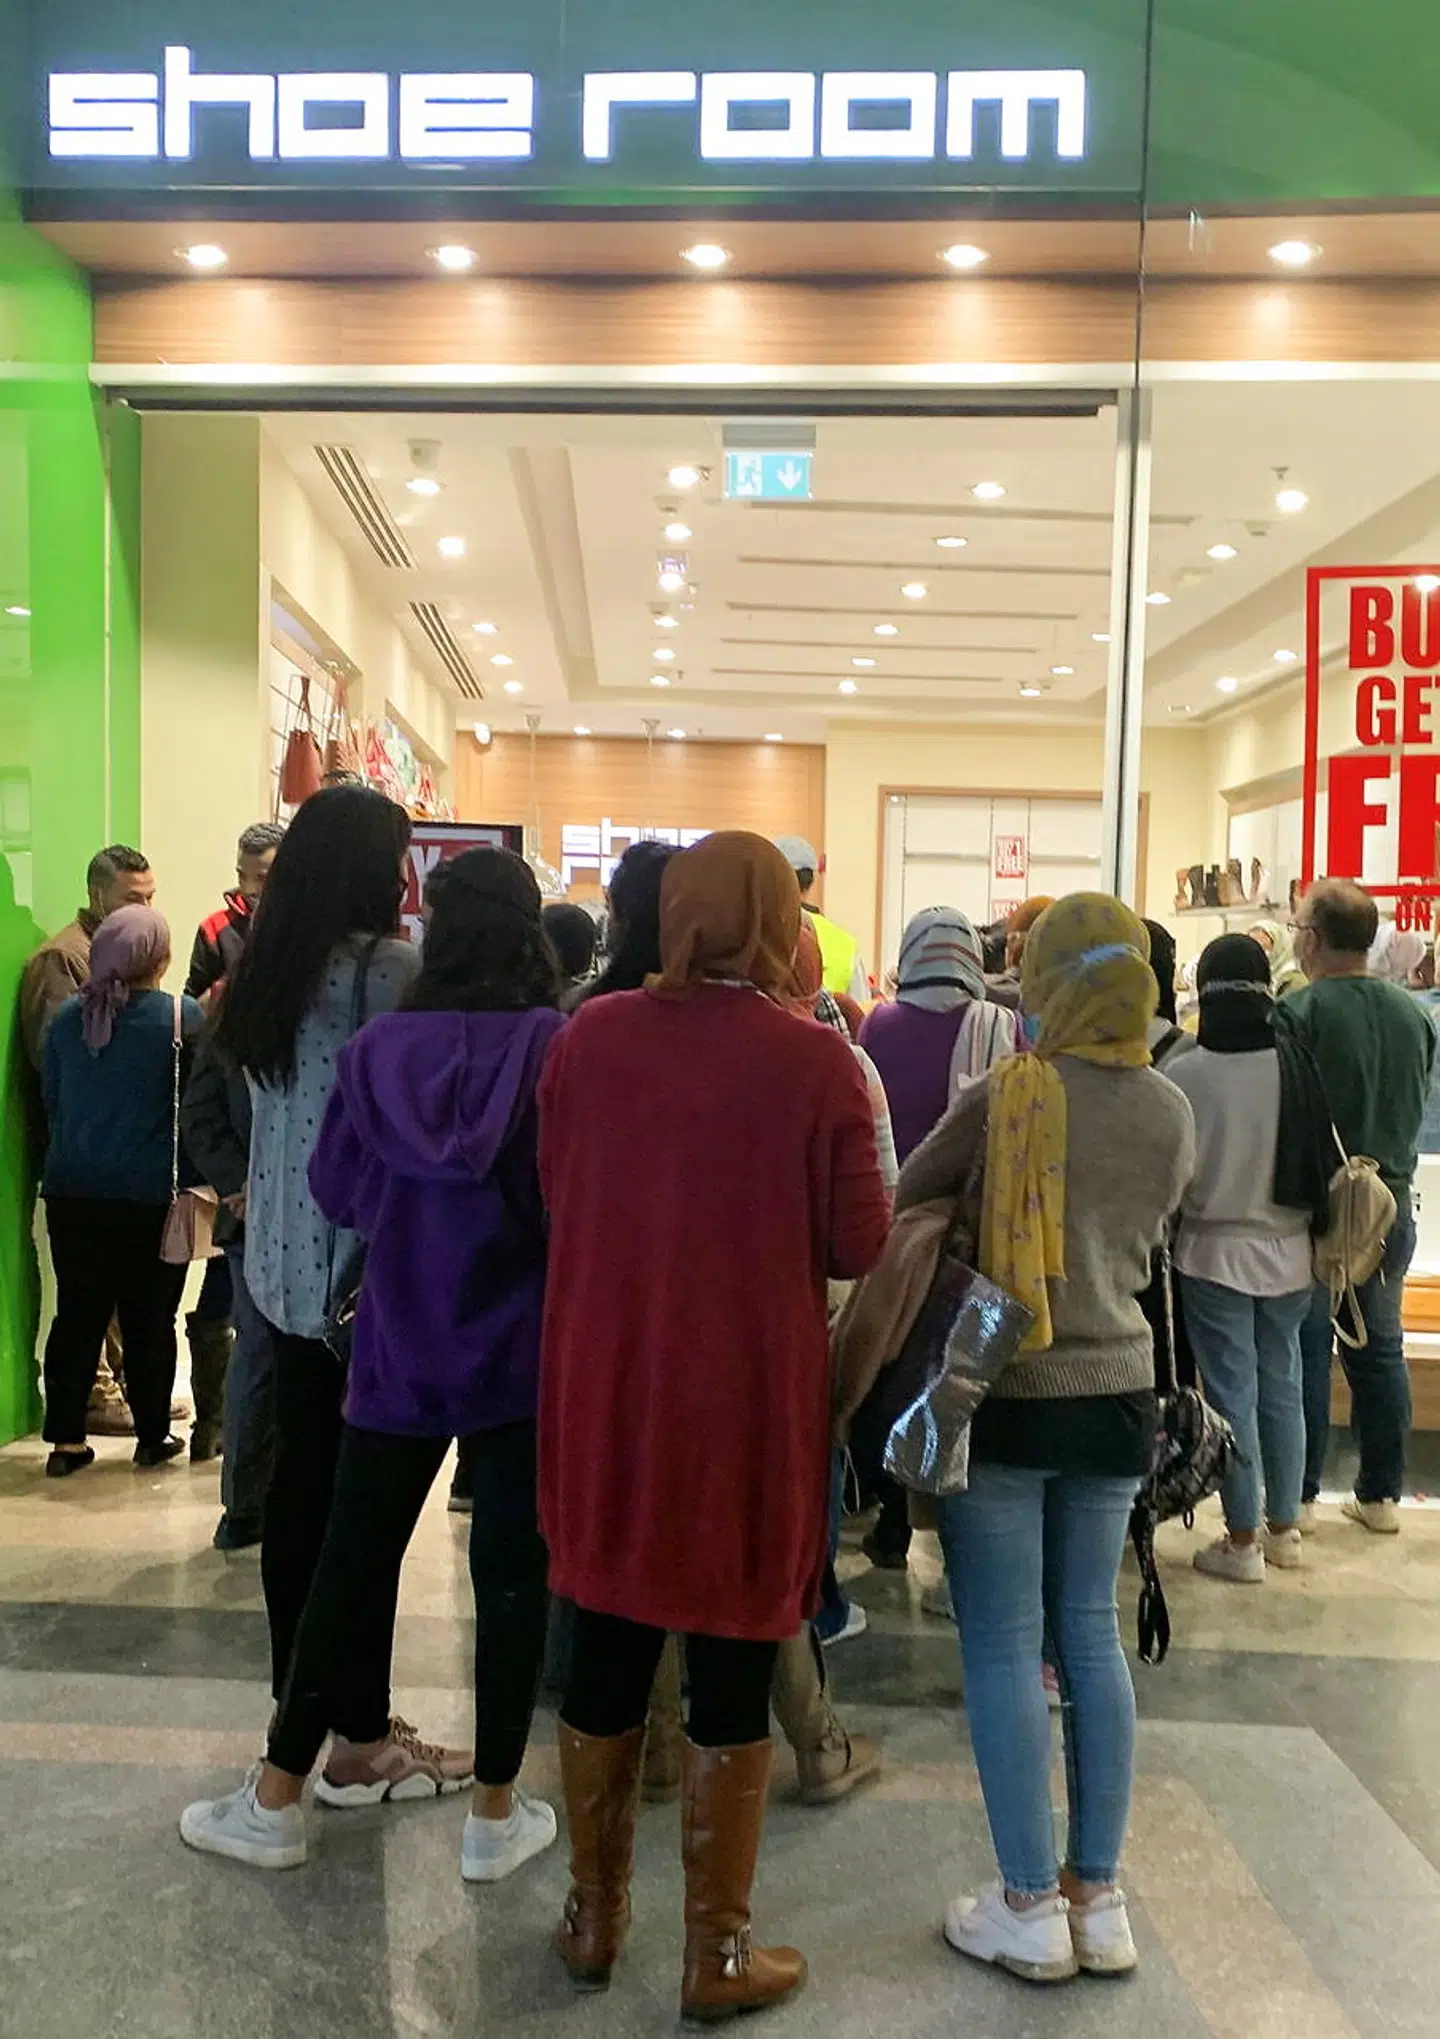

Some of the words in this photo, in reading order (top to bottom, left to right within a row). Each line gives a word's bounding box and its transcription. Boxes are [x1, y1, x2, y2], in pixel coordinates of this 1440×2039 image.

[49, 45, 533, 159] shoe
[583, 70, 1086, 159] room
[1355, 675, 1440, 747] GE
[1395, 900, 1432, 932] ON
